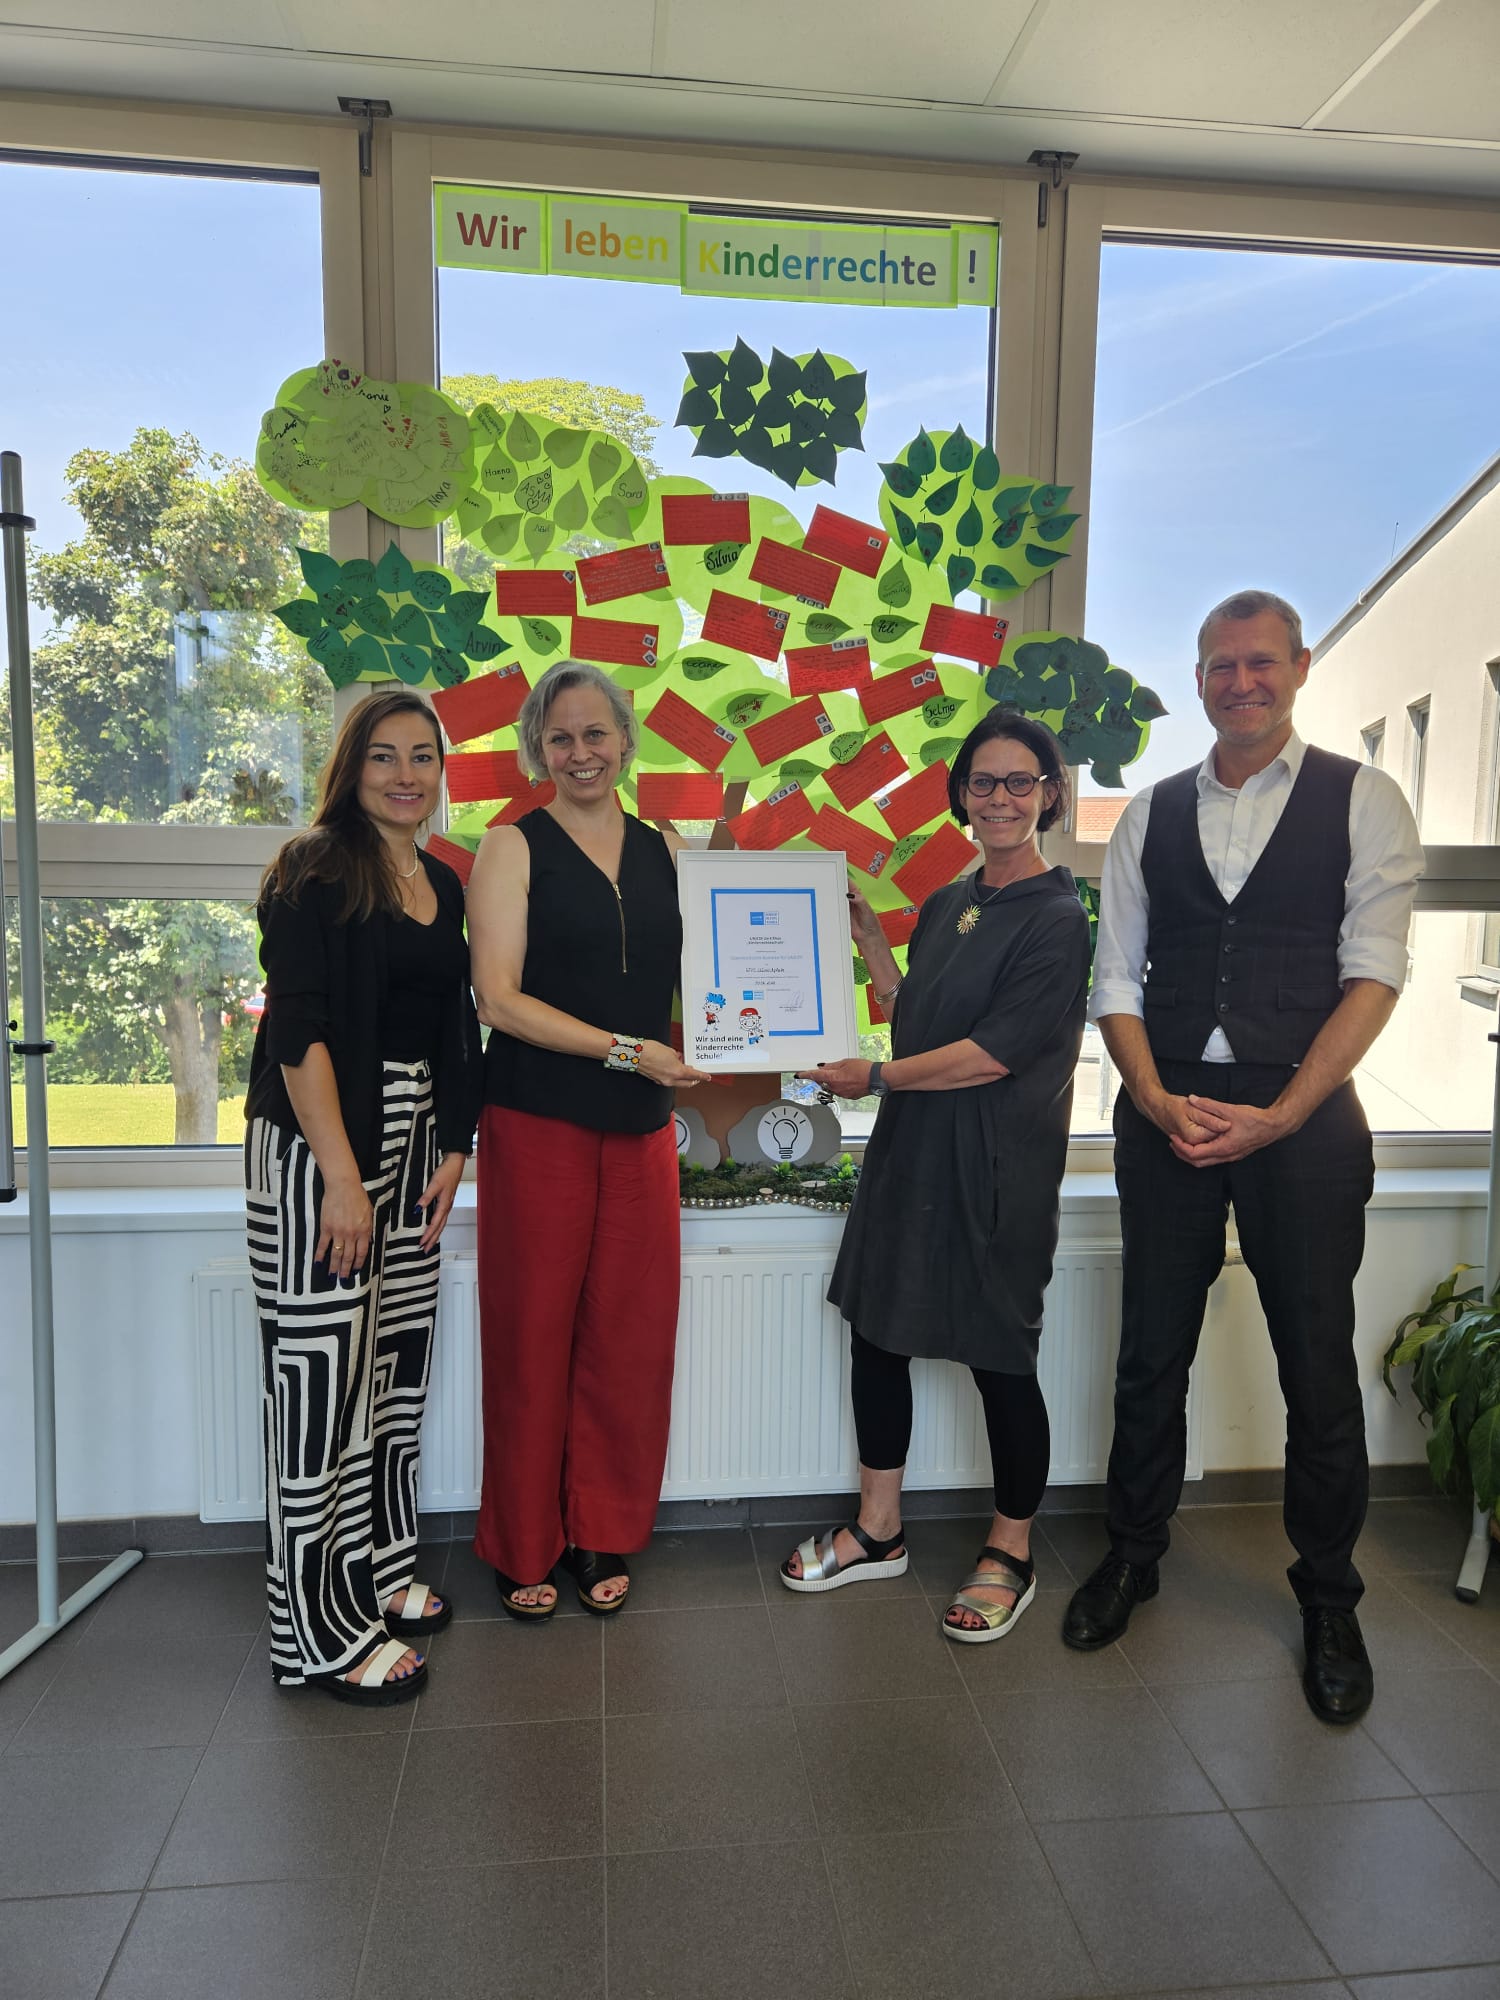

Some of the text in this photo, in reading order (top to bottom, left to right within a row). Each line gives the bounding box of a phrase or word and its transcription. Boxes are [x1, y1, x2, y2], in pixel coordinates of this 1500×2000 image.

[456, 211, 527, 251] Wir
[564, 218, 668, 262] leben
[698, 240, 937, 287] Kinderrechte
[705, 545, 739, 571] Silvia
[464, 631, 501, 655] Arvin
[924, 702, 956, 719] Selma
[695, 1035, 709, 1043] Wir
[710, 1035, 726, 1043] sind
